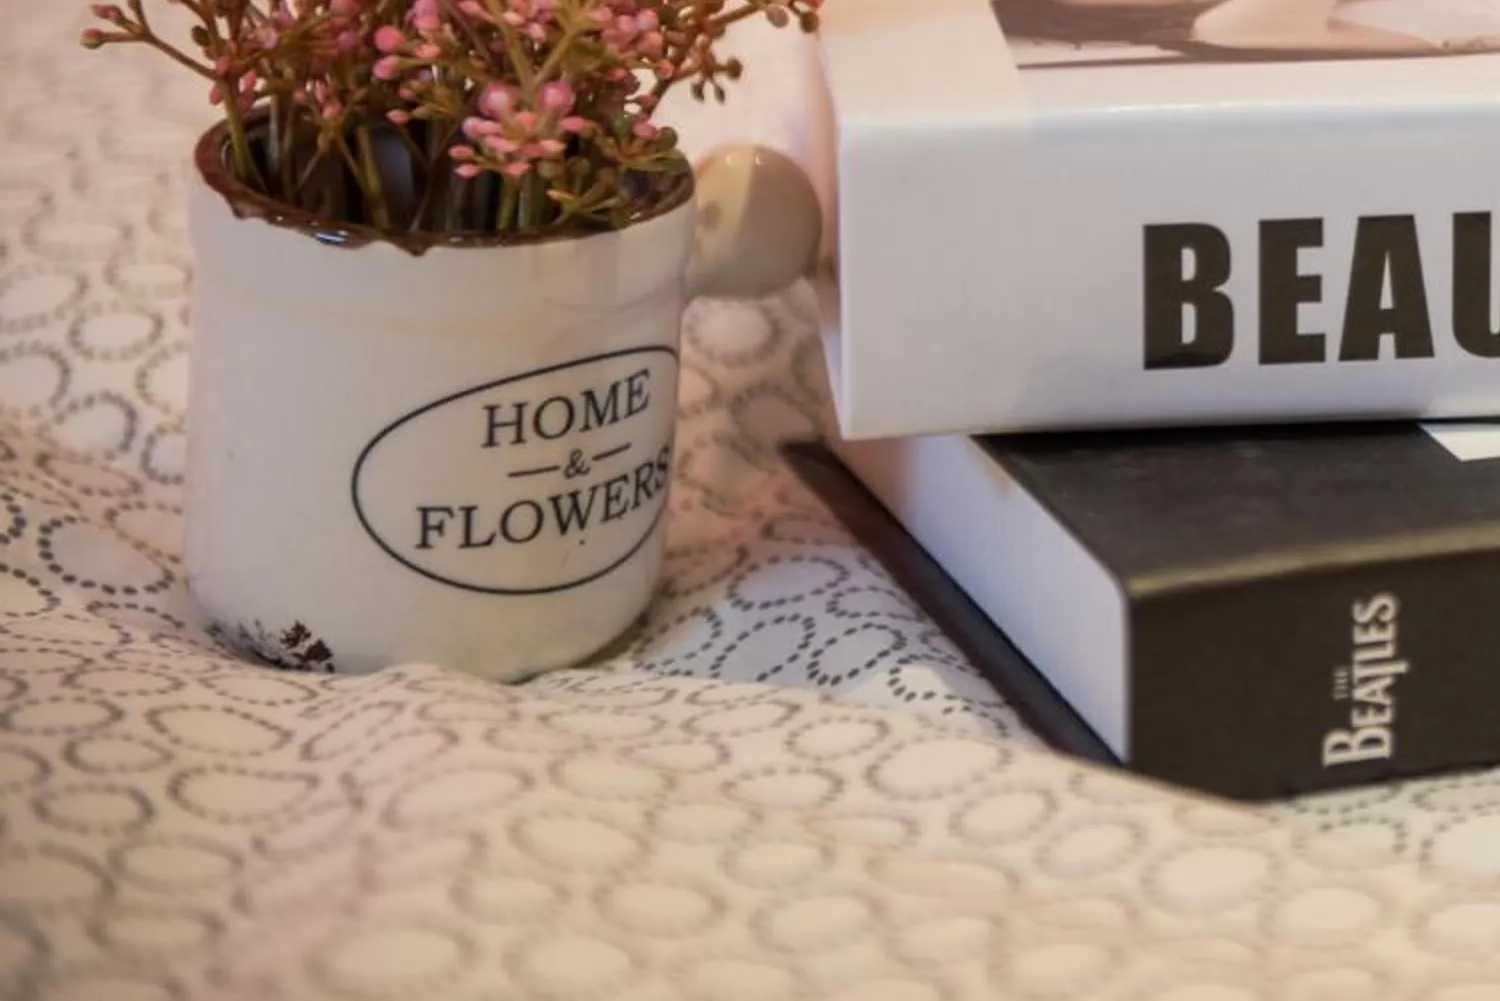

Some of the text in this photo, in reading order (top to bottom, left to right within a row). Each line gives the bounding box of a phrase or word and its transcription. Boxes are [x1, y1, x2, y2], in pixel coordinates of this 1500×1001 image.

[480, 367, 652, 449] HOME
[414, 441, 672, 550] FLOWERS
[562, 448, 592, 480] &
[1321, 591, 1410, 767] BEATLES
